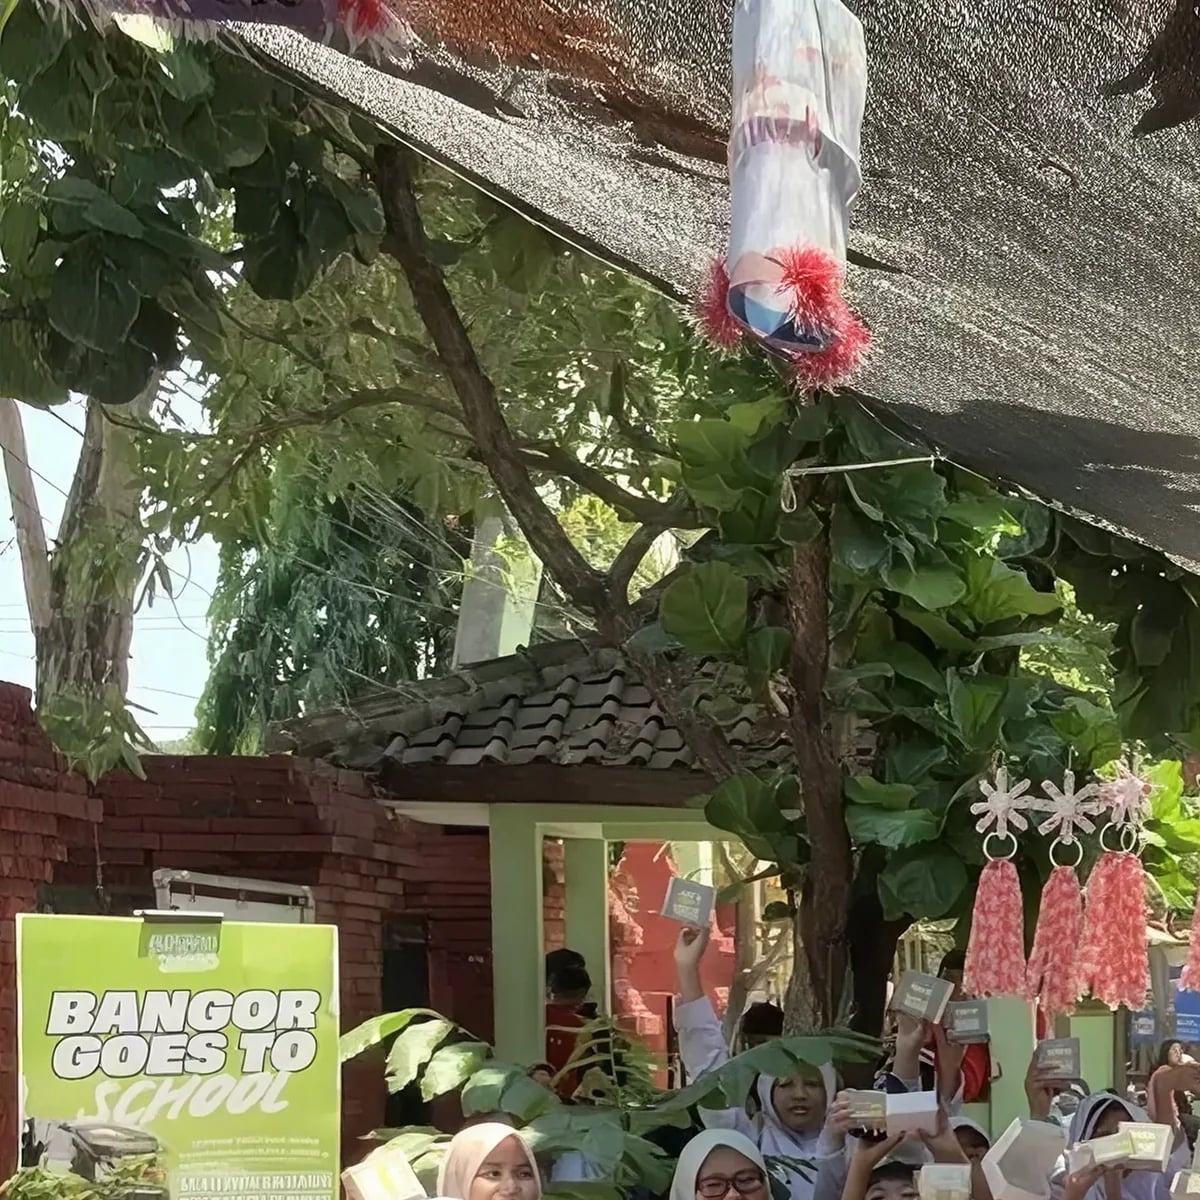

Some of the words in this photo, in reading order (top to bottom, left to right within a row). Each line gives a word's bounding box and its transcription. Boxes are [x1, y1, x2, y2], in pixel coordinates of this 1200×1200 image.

[46, 989, 322, 1035] BANGOR
[51, 1031, 229, 1080] GOES
[238, 1029, 318, 1074] TO
[76, 1071, 290, 1127] SCHOOL
